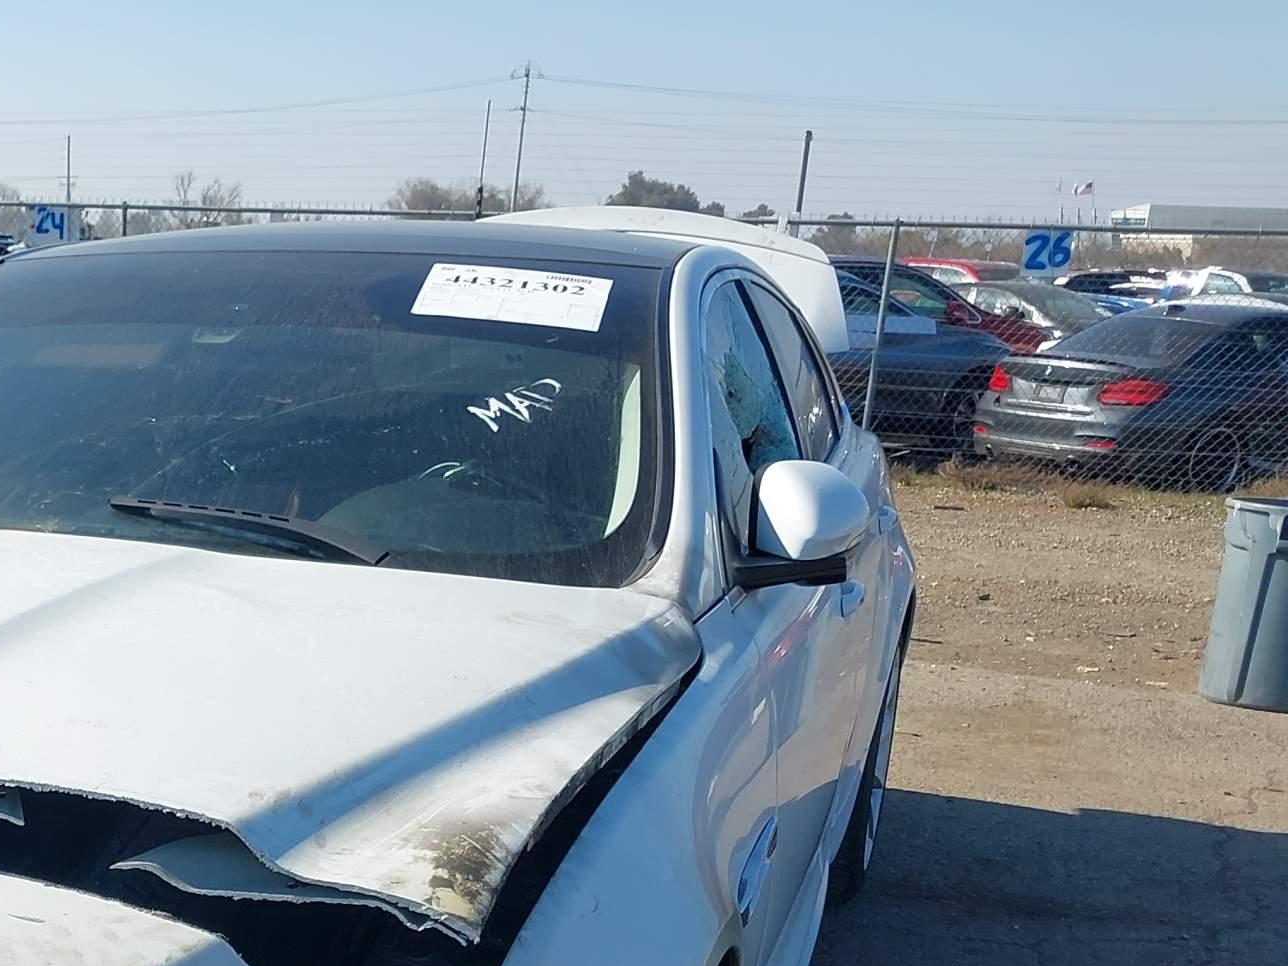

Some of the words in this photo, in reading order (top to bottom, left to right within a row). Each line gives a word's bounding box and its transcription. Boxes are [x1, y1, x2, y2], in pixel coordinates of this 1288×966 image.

[36, 207, 64, 240] 24
[1024, 232, 1071, 270] 26
[445, 275, 586, 296] 44321302
